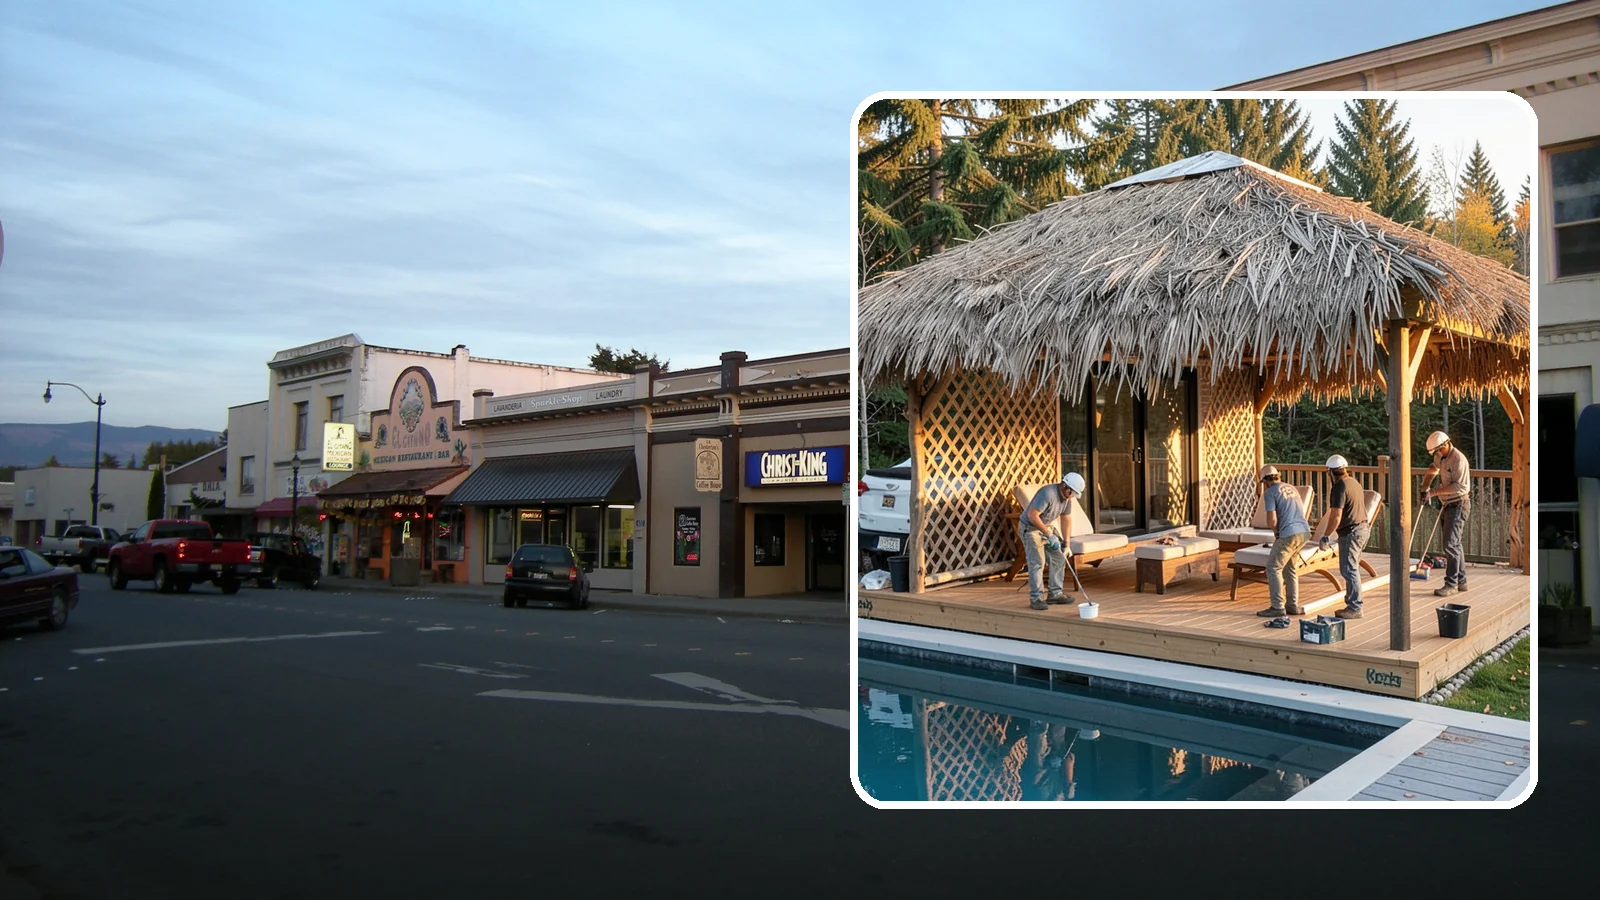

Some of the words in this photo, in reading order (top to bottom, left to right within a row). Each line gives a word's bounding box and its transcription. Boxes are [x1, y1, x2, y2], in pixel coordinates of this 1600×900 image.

[531, 397, 560, 409] Sparkle
[561, 394, 582, 405] Shop
[595, 389, 624, 400] LAUNDRY
[493, 402, 522, 412] LAVANDERIA
[374, 455, 396, 464] MEXICAN
[398, 451, 433, 462] RESTAURANT
[438, 450, 450, 458] BAR
[761, 452, 797, 478] CHRIST
[799, 450, 827, 476] KING
